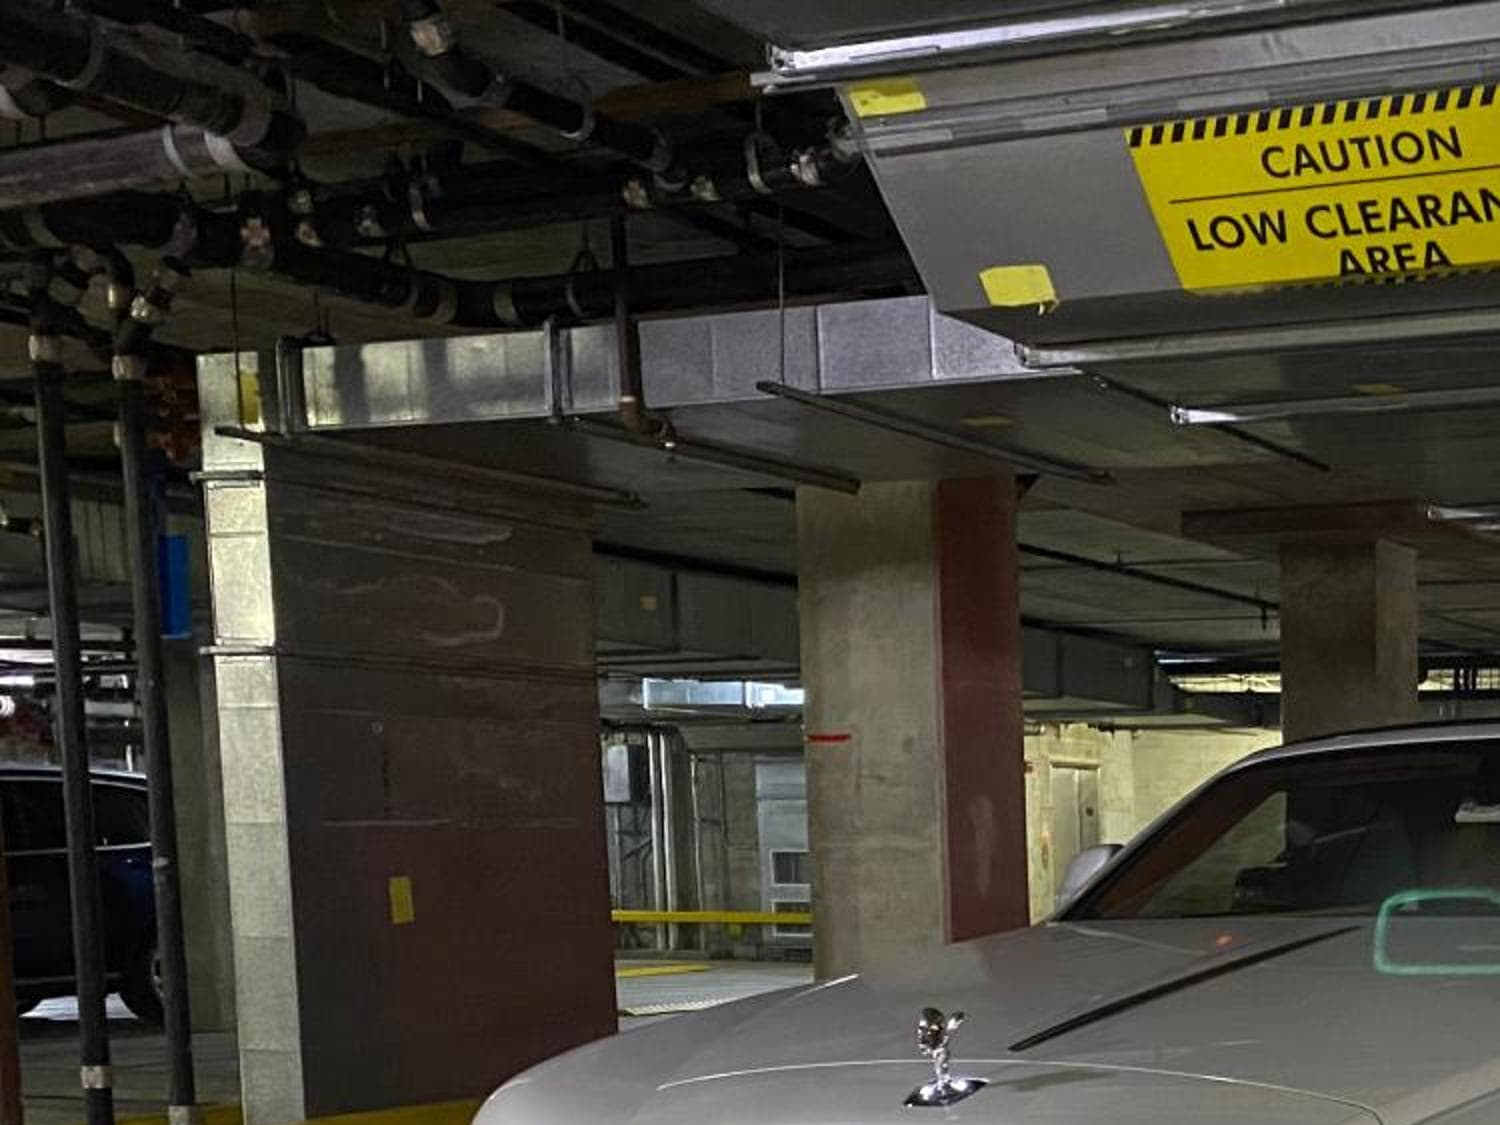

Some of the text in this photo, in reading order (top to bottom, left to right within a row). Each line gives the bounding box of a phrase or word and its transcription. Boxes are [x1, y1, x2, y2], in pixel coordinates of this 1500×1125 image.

[1261, 126, 1462, 178] CAUTION
[1187, 209, 1288, 251] LOW
[1340, 240, 1452, 276] AREA
